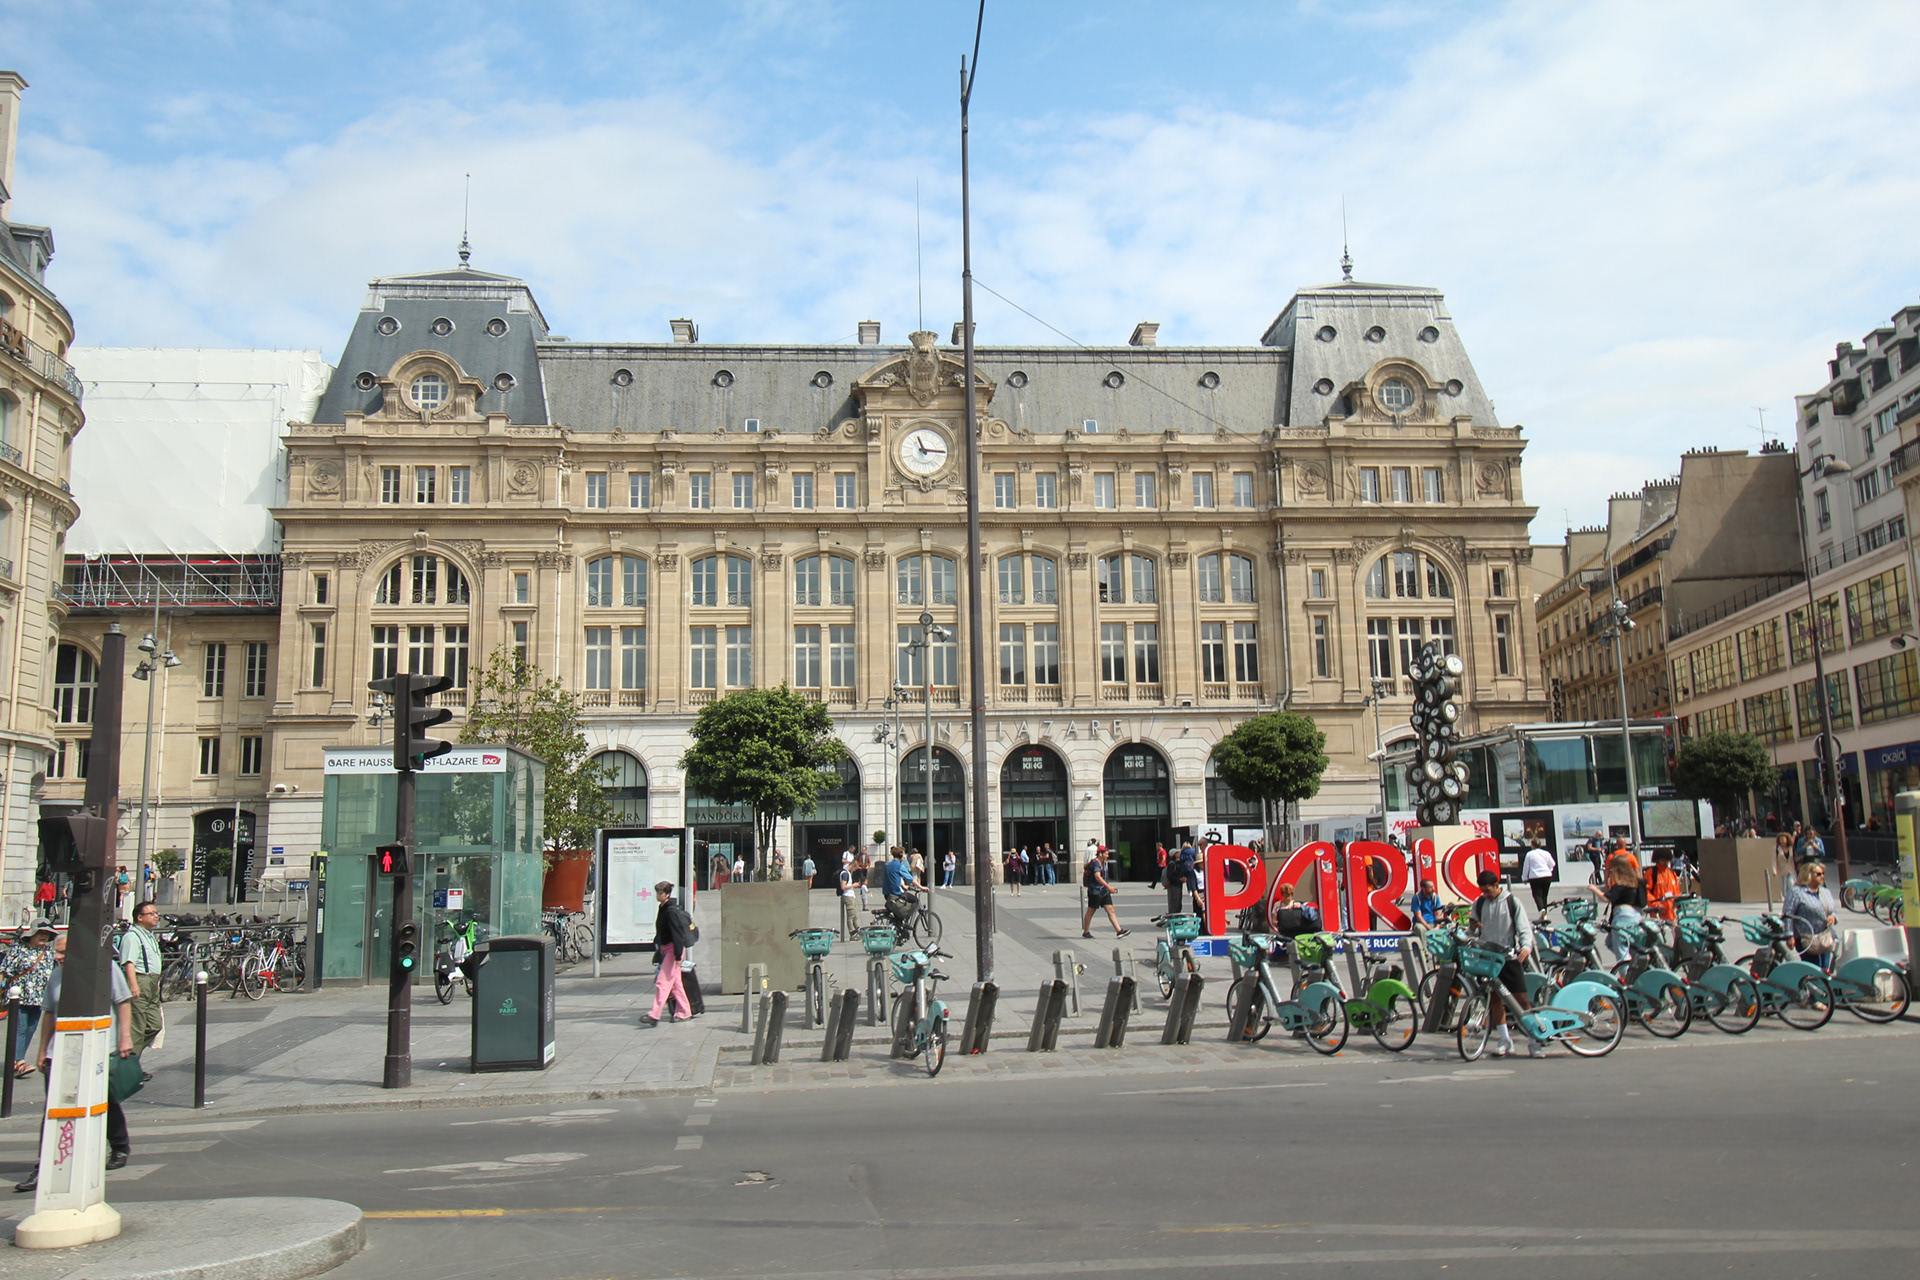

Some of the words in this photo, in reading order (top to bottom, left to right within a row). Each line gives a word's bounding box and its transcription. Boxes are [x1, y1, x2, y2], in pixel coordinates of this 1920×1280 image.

[1000, 719, 1123, 738] LAZARE
[328, 758, 356, 767] GARE
[359, 758, 393, 767] HAUSS
[424, 757, 479, 766] ST-LAZARE
[919, 763, 940, 771] KG
[192, 846, 204, 898] L'USINE
[1373, 938, 1399, 948] RUG
